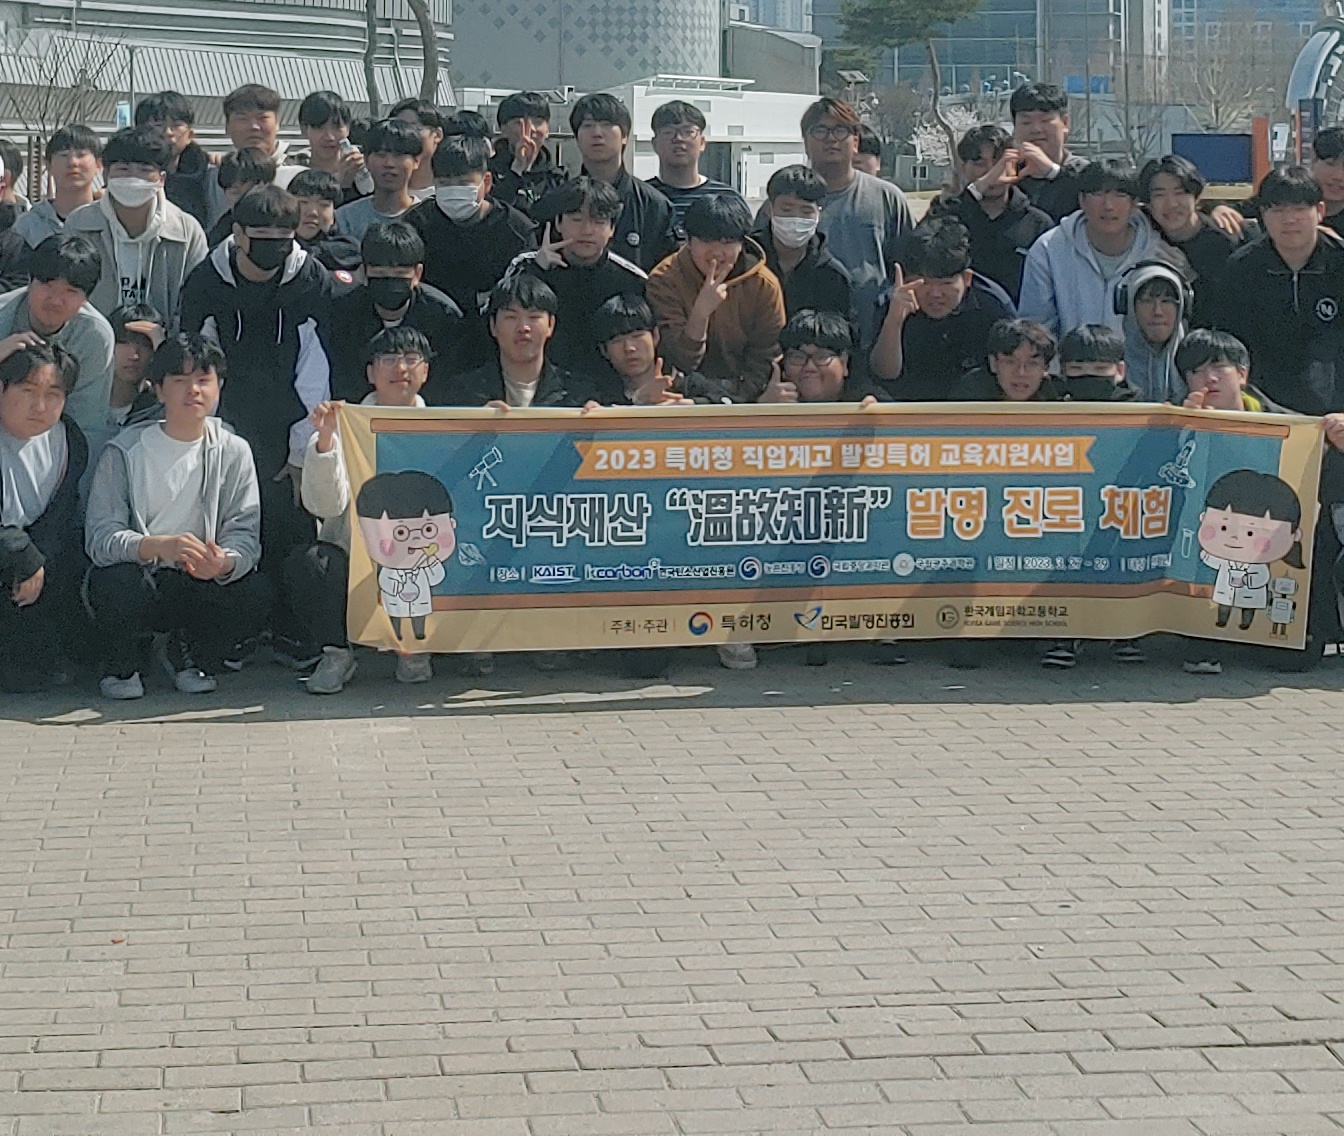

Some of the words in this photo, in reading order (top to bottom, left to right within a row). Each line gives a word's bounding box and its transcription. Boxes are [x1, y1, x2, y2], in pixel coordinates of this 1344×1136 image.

[594, 449, 656, 470] 2023
[665, 446, 733, 471] 특허청
[742, 445, 833, 470] 직업계고
[841, 443, 930, 468] 발명특허
[939, 442, 1075, 467] 교육지원사업
[483, 493, 653, 548] 지식재산
[906, 486, 987, 541] 발명
[1003, 486, 1085, 539] 진로
[1100, 485, 1173, 540] 체험
[532, 565, 577, 578] KAIST
[720, 613, 772, 632] 특허청
[821, 612, 915, 630] 한국발명진흥회
